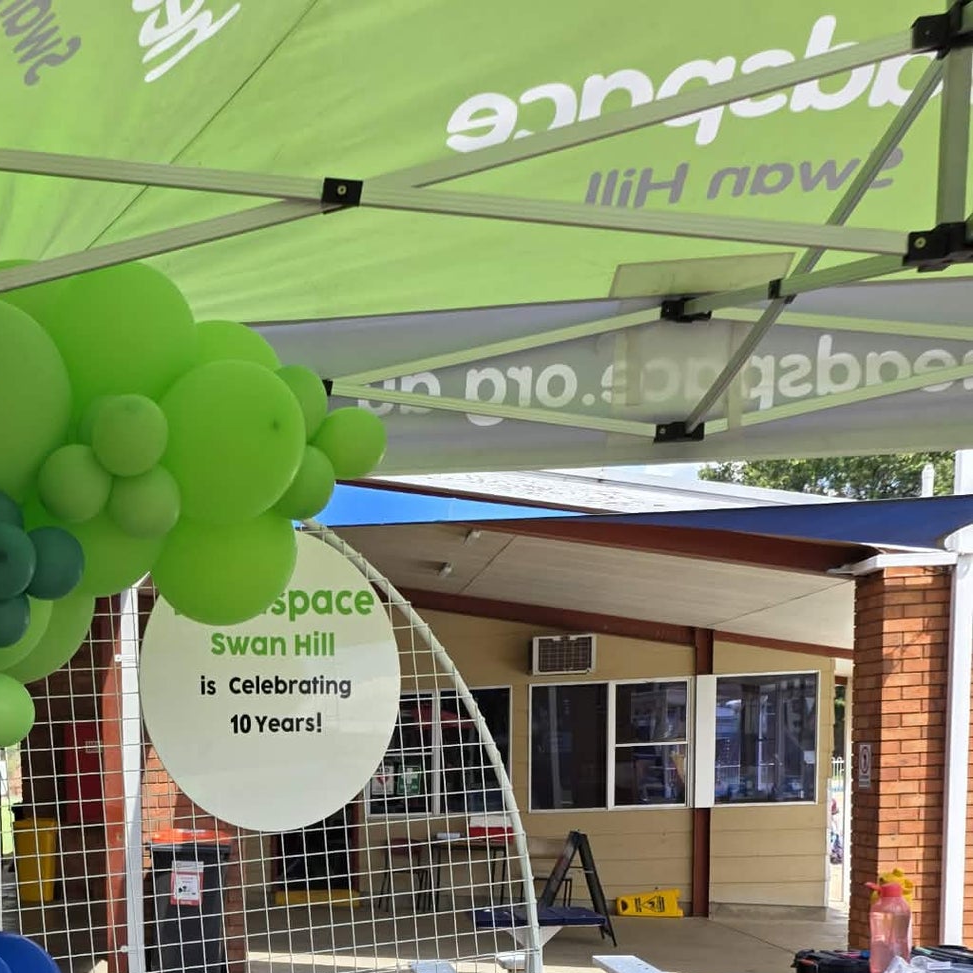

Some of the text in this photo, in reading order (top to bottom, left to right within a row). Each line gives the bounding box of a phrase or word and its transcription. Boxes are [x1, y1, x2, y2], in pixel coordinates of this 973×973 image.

[211, 632, 336, 657] Swan Hill
[200, 676, 352, 699] is Celebrating
[230, 712, 323, 734] 10 Years!
